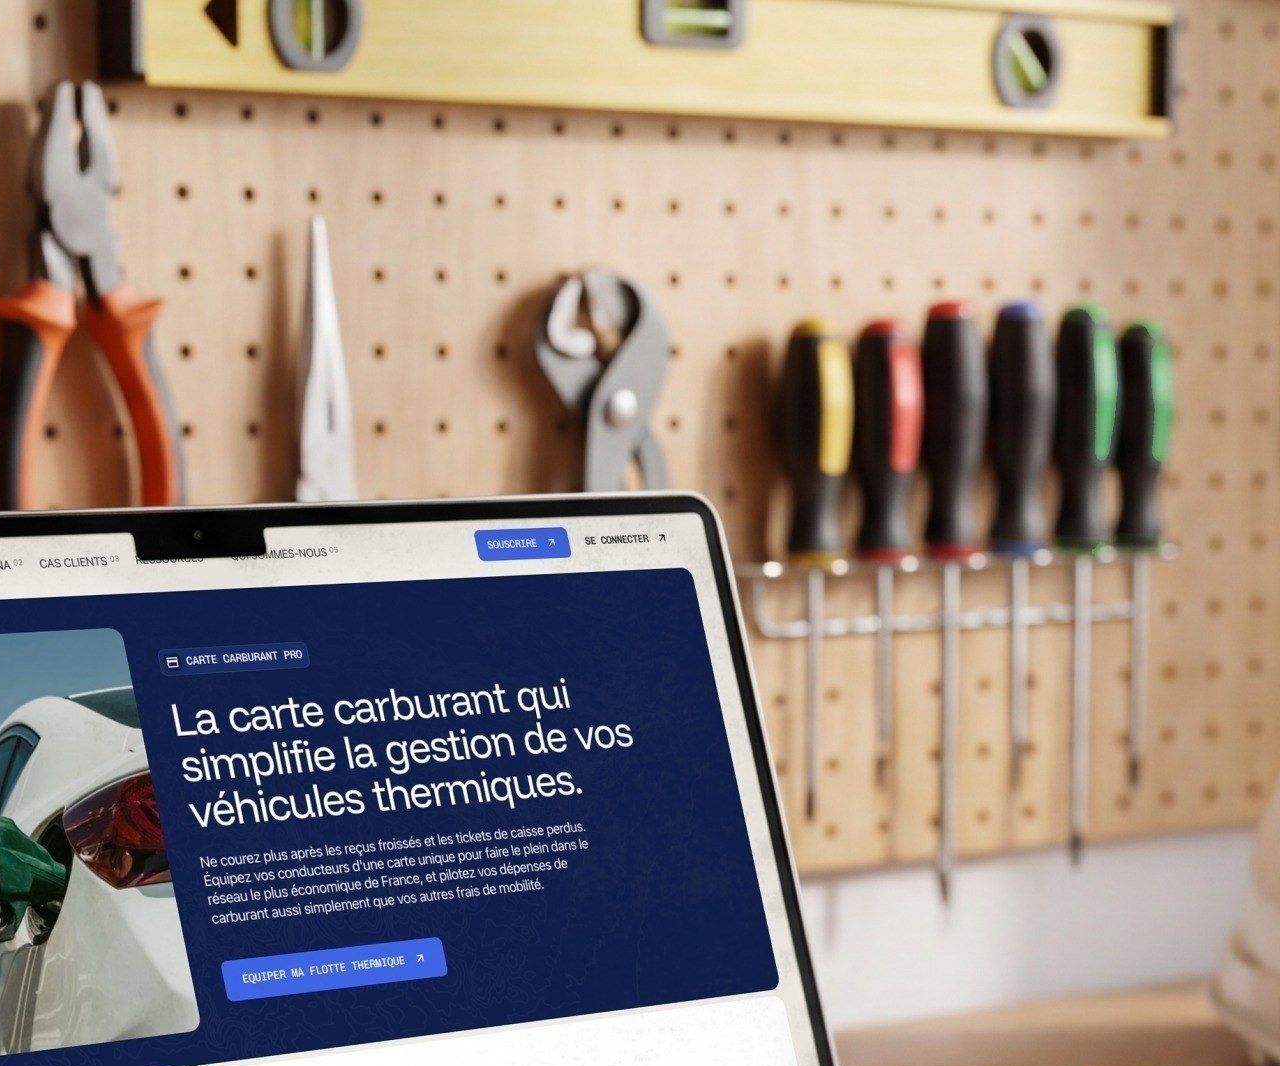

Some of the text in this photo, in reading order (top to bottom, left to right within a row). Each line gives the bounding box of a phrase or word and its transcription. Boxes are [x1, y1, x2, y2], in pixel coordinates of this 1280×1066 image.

[13, 558, 23, 567] 02
[39, 555, 120, 568] CAS CLIENTS 03
[487, 538, 537, 549] SOUSCRIRE
[585, 534, 649, 545] SE CONNECTER
[186, 650, 303, 665] CARTE CARBURANT PRO
[171, 677, 571, 737] La carte carburant qui
[182, 721, 634, 786] simplifie la gestion de vos
[188, 770, 583, 828] véhicules thermiques.
[200, 822, 586, 868] Ne courez plus après les reçus froissés et les tickets de caisse perdus.
[203, 872, 252, 889] Équipez
[254, 871, 275, 882] vos
[278, 863, 350, 879] conducteurs
[387, 855, 416, 868] carte
[418, 851, 456, 868] unique
[458, 850, 483, 864] pour
[485, 847, 509, 859] faire
[511, 845, 521, 856] le
[523, 842, 549, 858] plein
[551, 839, 577, 852] dans
[578, 838, 589, 849] le
[207, 858, 568, 905] réseau le plus économique de France, et pilotez vos dépenses de
[211, 878, 545, 925] carburant aussi simplement que vos autres frais de mobilité.
[242, 956, 406, 984] ÉQUIPER MA FLOTTE THERMIQUE
